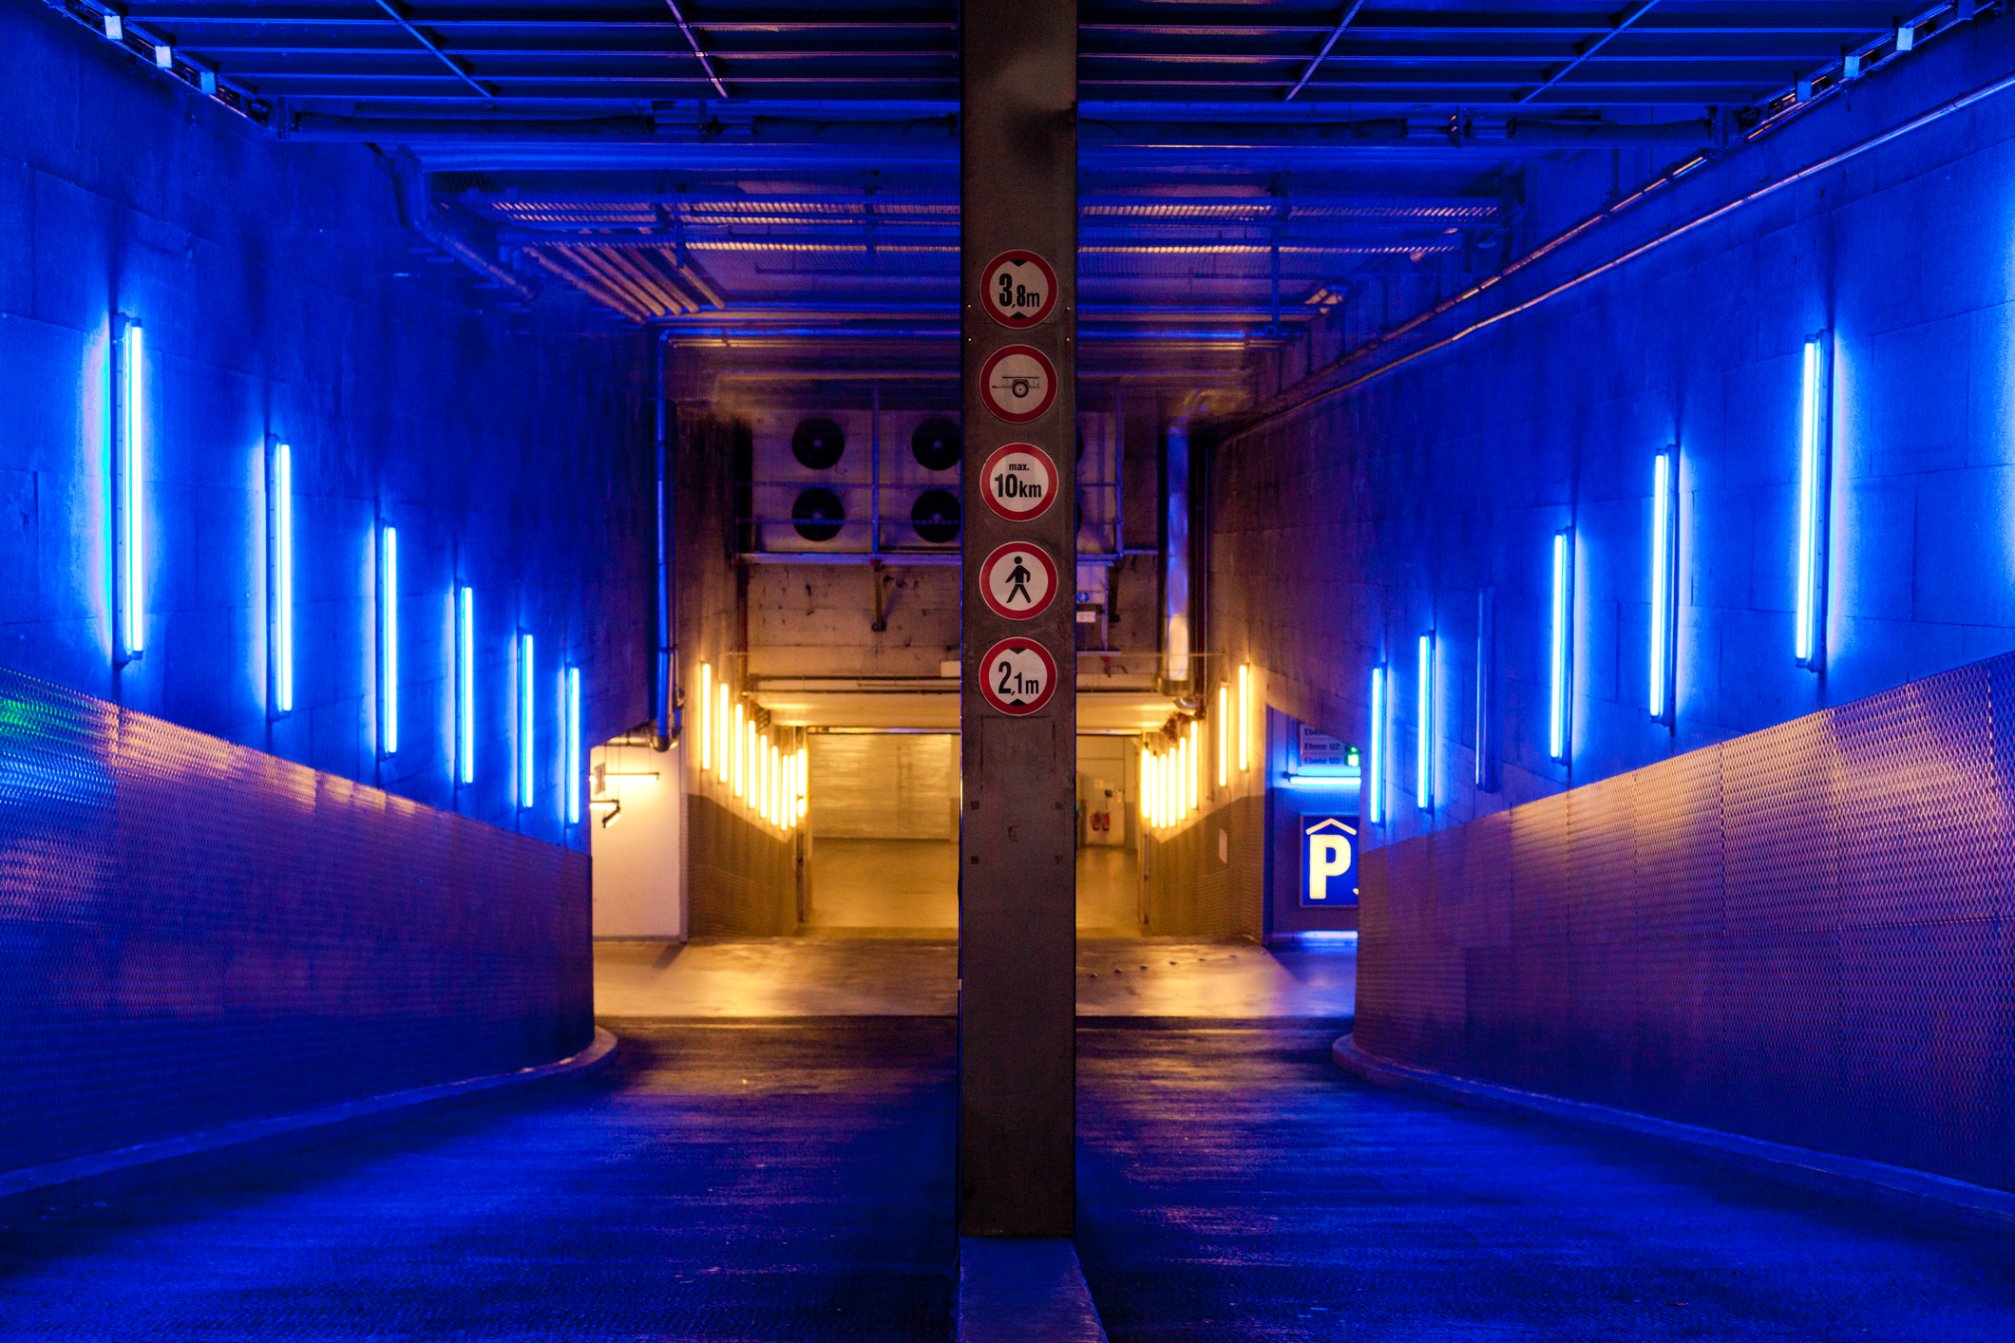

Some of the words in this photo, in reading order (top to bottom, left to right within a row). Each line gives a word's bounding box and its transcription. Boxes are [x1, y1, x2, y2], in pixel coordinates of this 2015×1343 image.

[999, 273, 1040, 309] 3,8m
[1008, 463, 1030, 471] max.
[994, 473, 1042, 498] 10km
[1309, 834, 1352, 900] P
